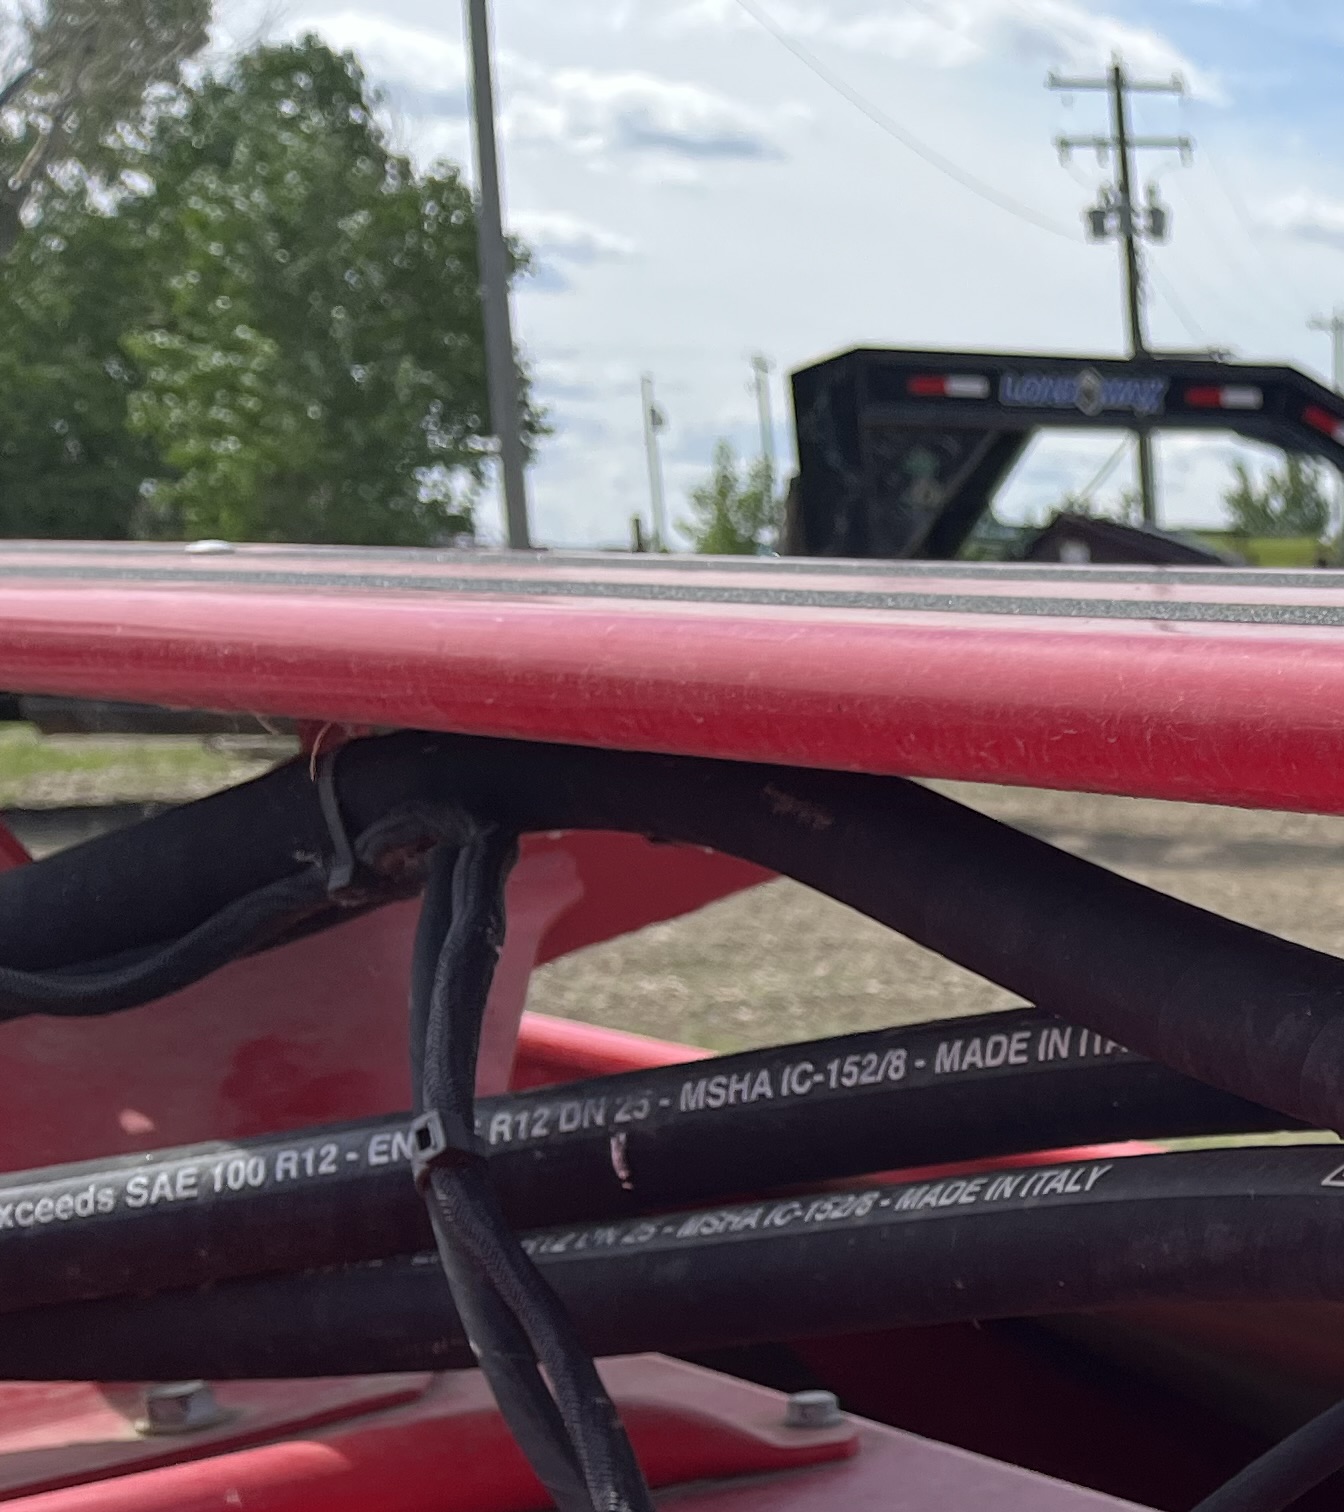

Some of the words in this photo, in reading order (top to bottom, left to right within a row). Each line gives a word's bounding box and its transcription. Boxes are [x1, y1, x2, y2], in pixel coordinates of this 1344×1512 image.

[126, 1168, 199, 1209] SAE
[211, 1156, 265, 1193] 100
[275, 1142, 339, 1181] R12
[489, 1107, 549, 1145] R12
[558, 1096, 606, 1133] DN
[680, 1068, 774, 1113] MSHA
[780, 1048, 907, 1097] IC-152/8
[934, 1030, 1032, 1073] MADE
[1038, 1025, 1072, 1062] IN
[895, 1179, 981, 1211] MADE
[985, 1174, 1017, 1200] IN
[1021, 1164, 1113, 1195] ITALY
